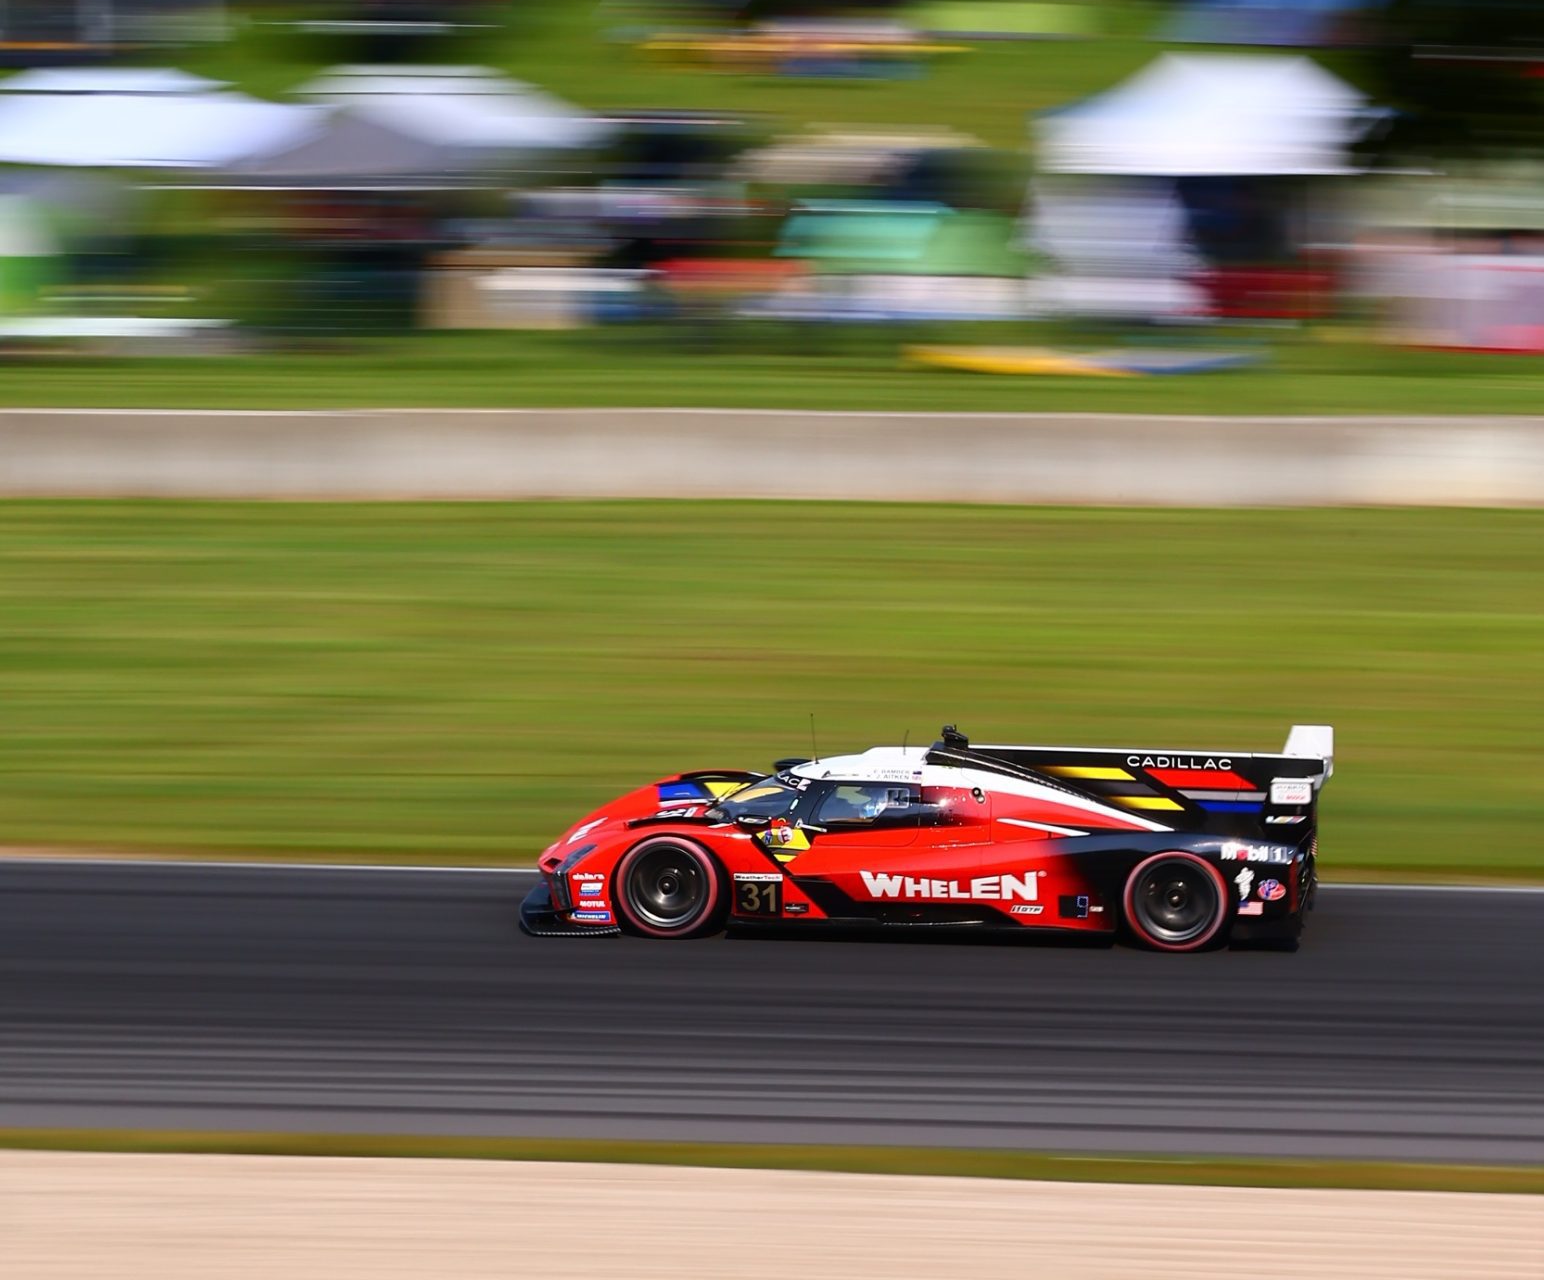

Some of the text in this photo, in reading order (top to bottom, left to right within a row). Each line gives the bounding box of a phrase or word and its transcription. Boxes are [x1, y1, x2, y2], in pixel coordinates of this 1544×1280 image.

[1126, 755, 1232, 771] CADILLAC
[1221, 842, 1268, 862] Mobil
[741, 883, 776, 913] 31
[859, 870, 1039, 901] WHELEN
